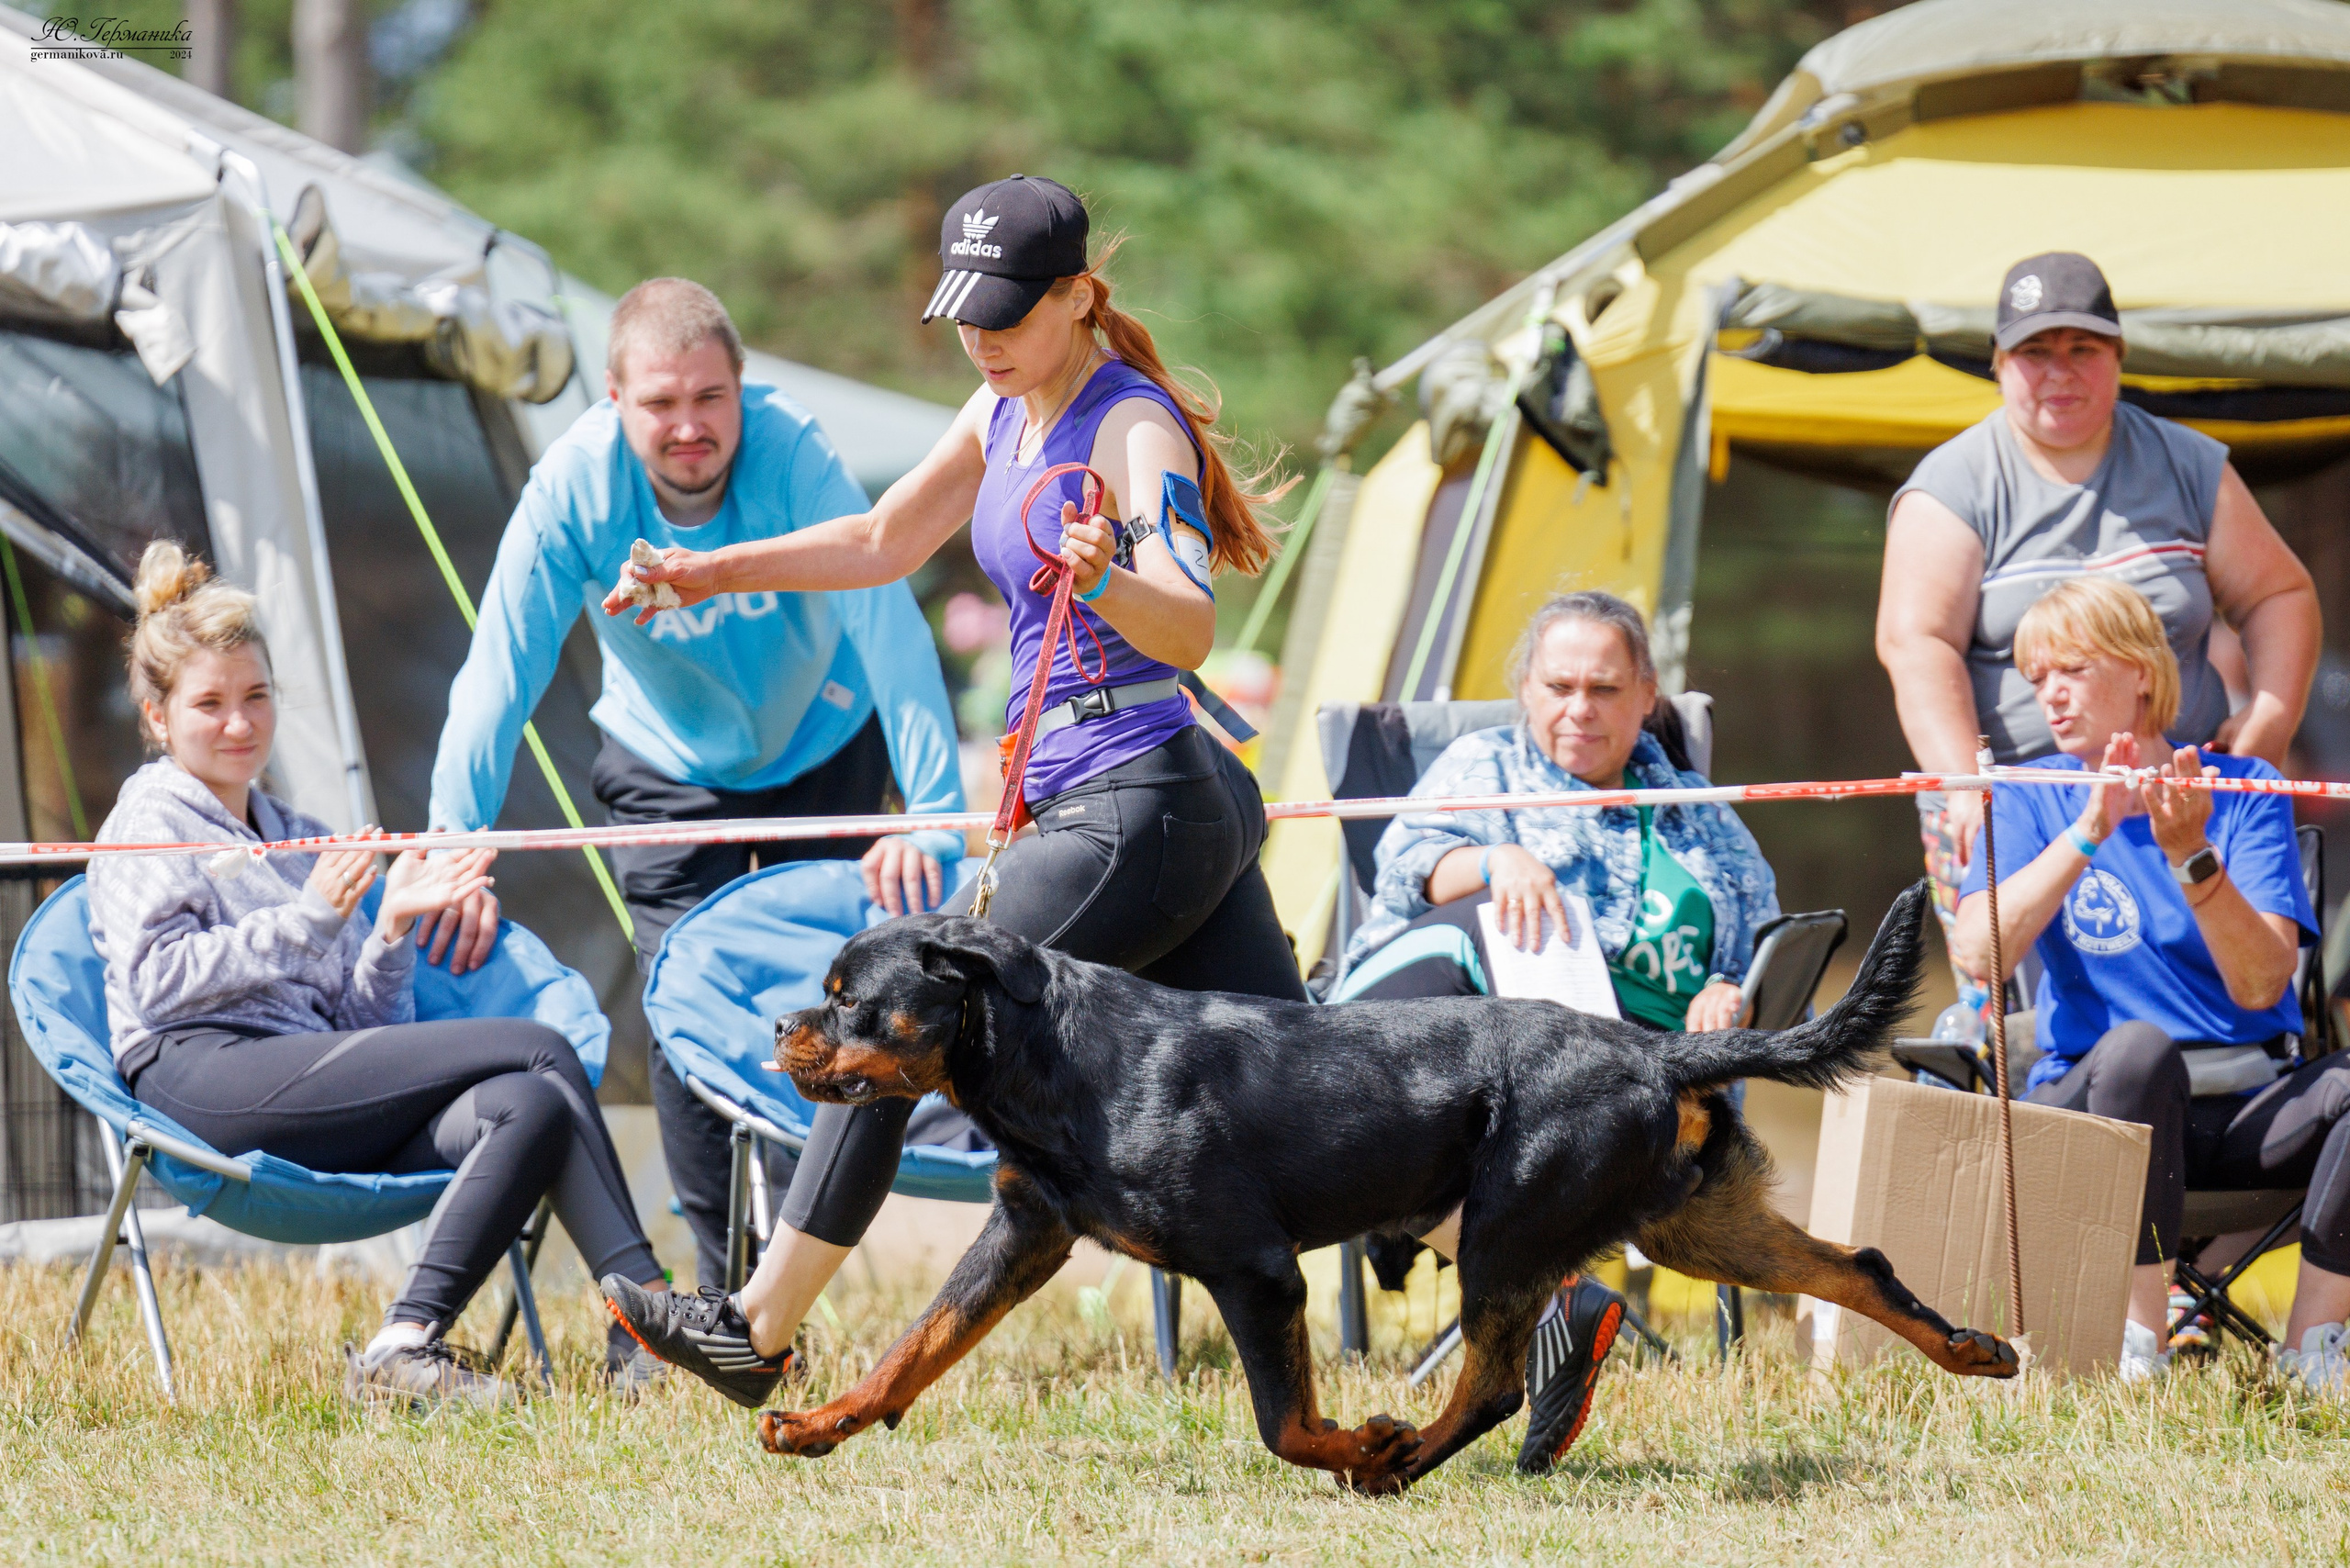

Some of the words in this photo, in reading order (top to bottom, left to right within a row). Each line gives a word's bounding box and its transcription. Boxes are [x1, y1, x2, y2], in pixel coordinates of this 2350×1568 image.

[950, 238, 1002, 260] adidas
[1194, 549, 1207, 569] 2
[1058, 804, 1086, 818] Reebok
